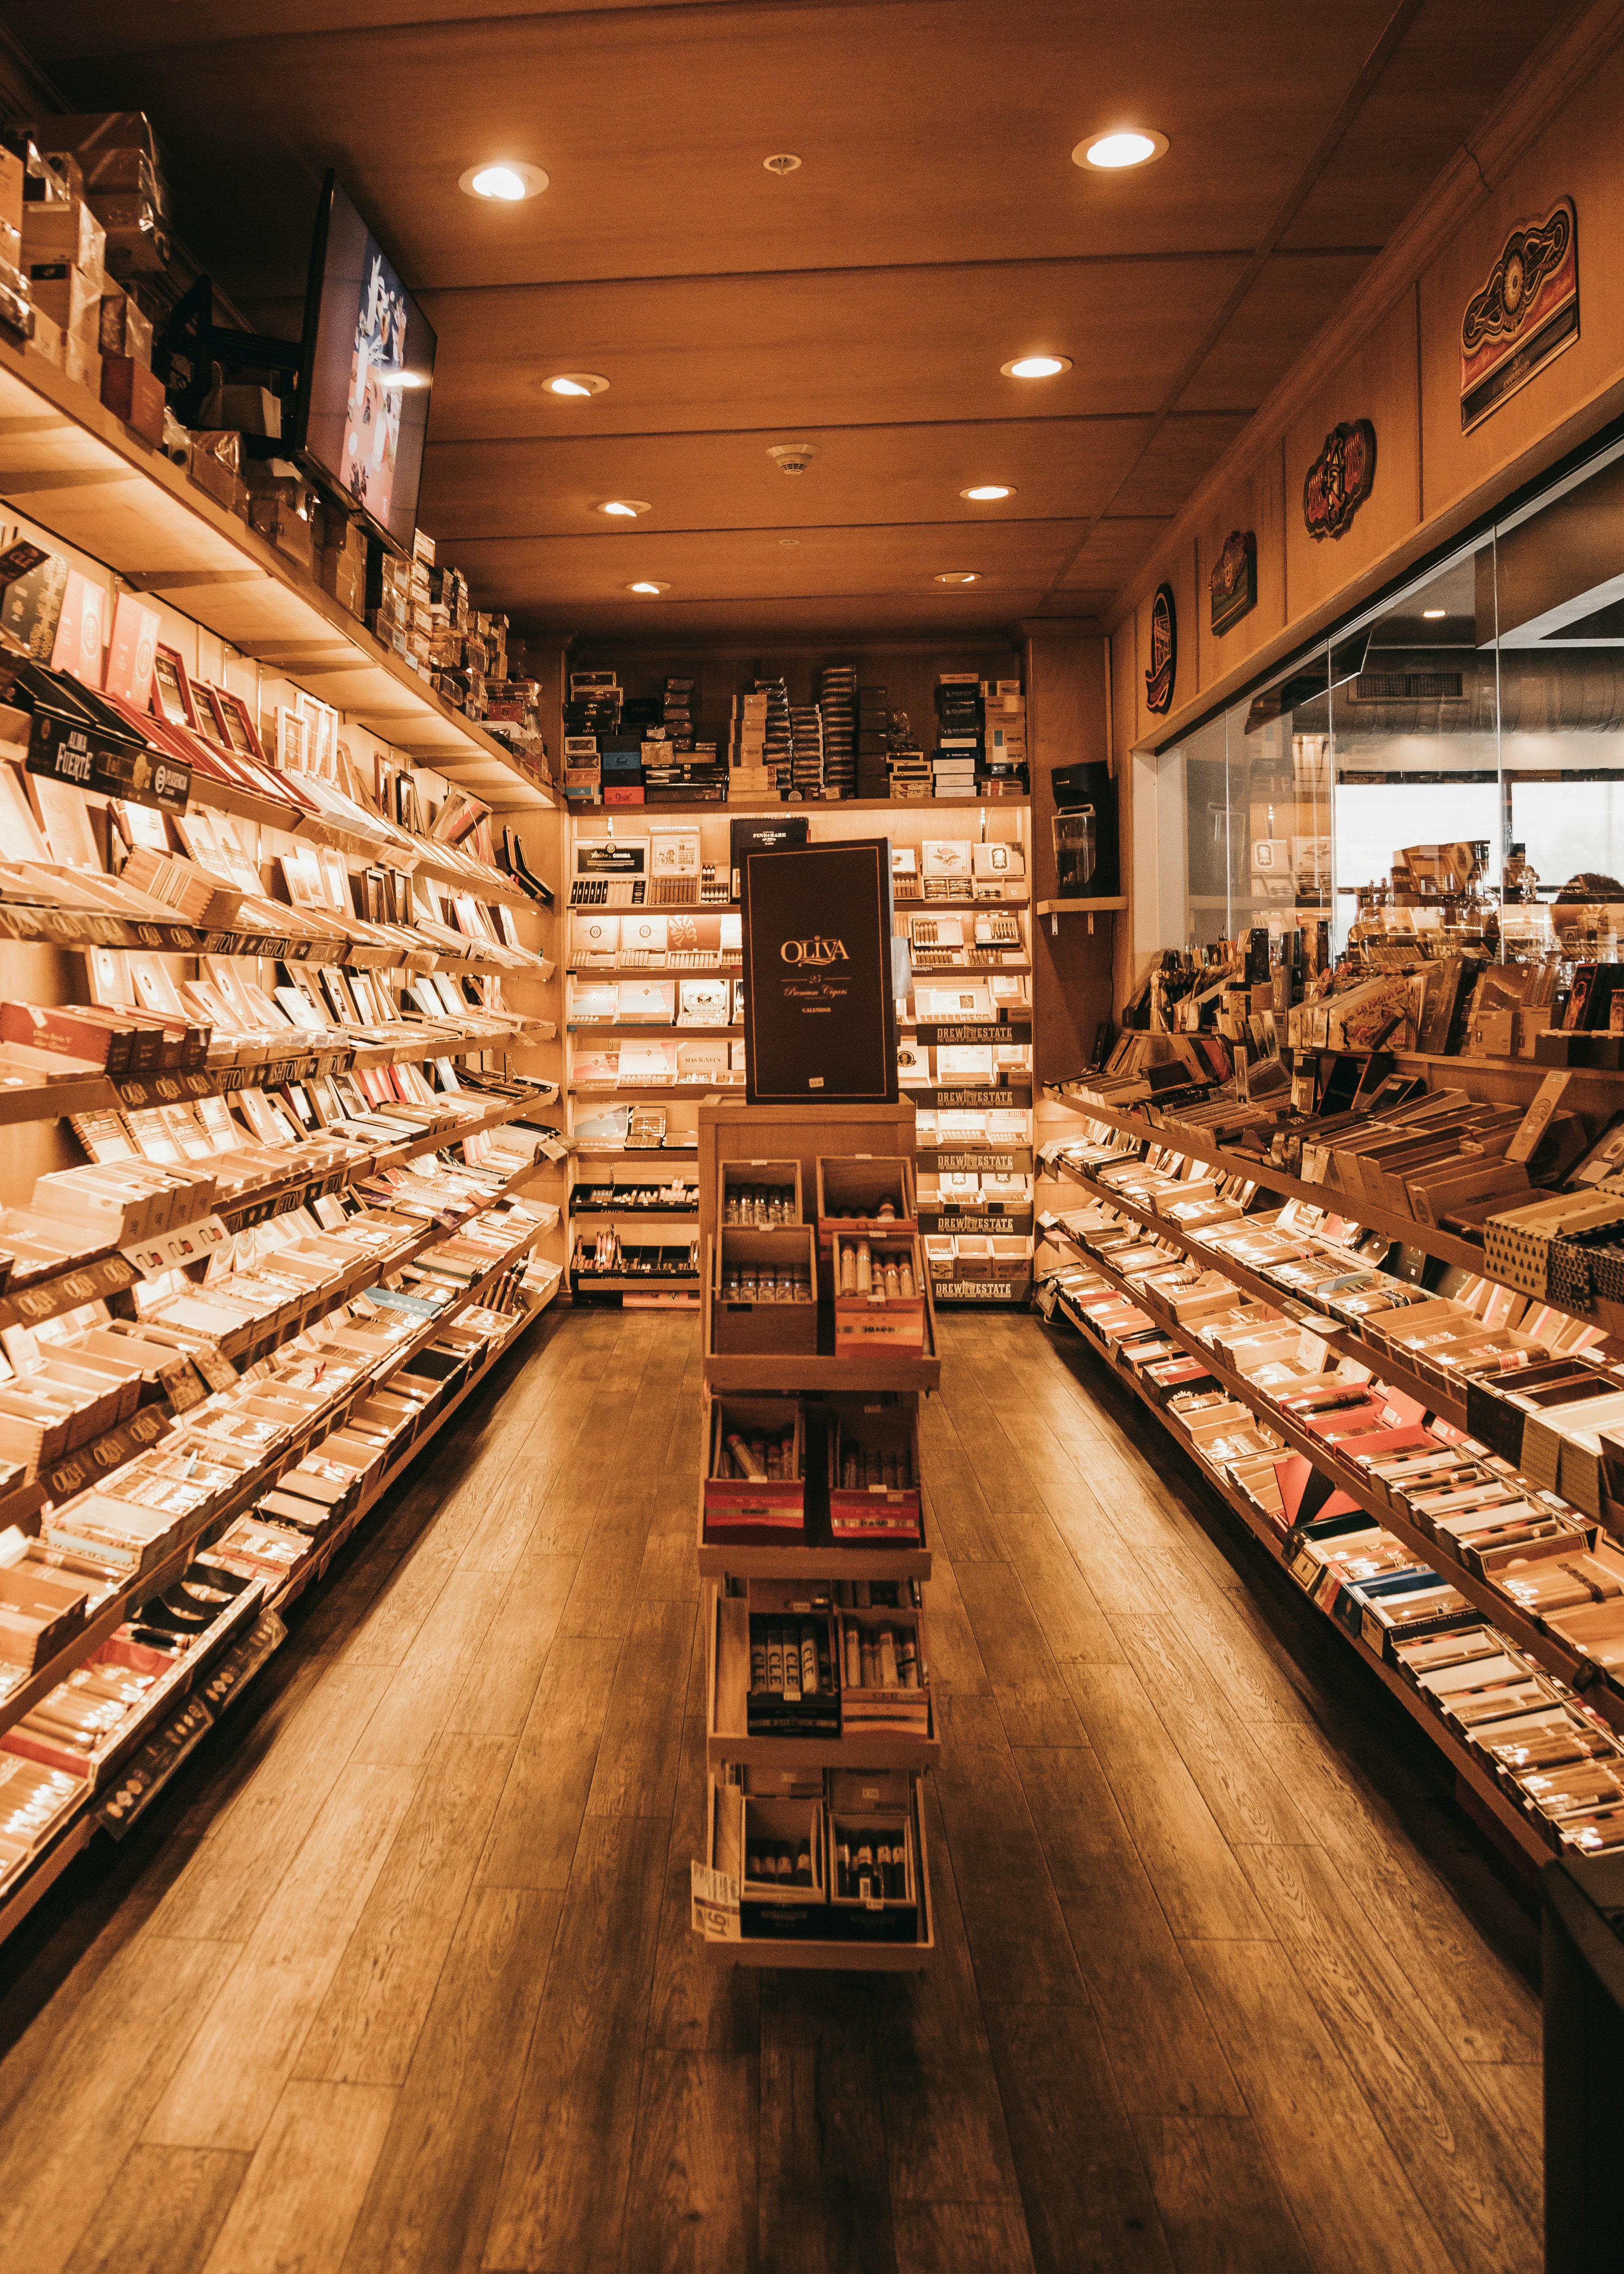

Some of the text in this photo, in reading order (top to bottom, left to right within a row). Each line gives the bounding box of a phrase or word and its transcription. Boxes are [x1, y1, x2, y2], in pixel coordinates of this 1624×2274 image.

[256, 938, 288, 957] ASHTON
[781, 935, 850, 967] OLIVA
[784, 984, 848, 999] Premium Cigars
[1356, 1005, 1368, 1016] LA
[1368, 990, 1395, 1010] AROMA
[937, 1027, 1012, 1037] DREW ESTATE
[937, 1092, 1012, 1102] DREW ESTATE
[938, 1156, 1013, 1165] DREW ESTATE
[938, 1218, 1013, 1228] DREW ESTATE
[199, 1226, 223, 1246] nub
[167, 1239, 194, 1258] nub
[136, 1252, 163, 1268] nub
[936, 1284, 1011, 1293] DREW ESTATE
[751, 1652, 765, 1685] CLE
[769, 1652, 782, 1685] CLE
[786, 1652, 798, 1685] CLE
[802, 1647, 813, 1678] CLE
